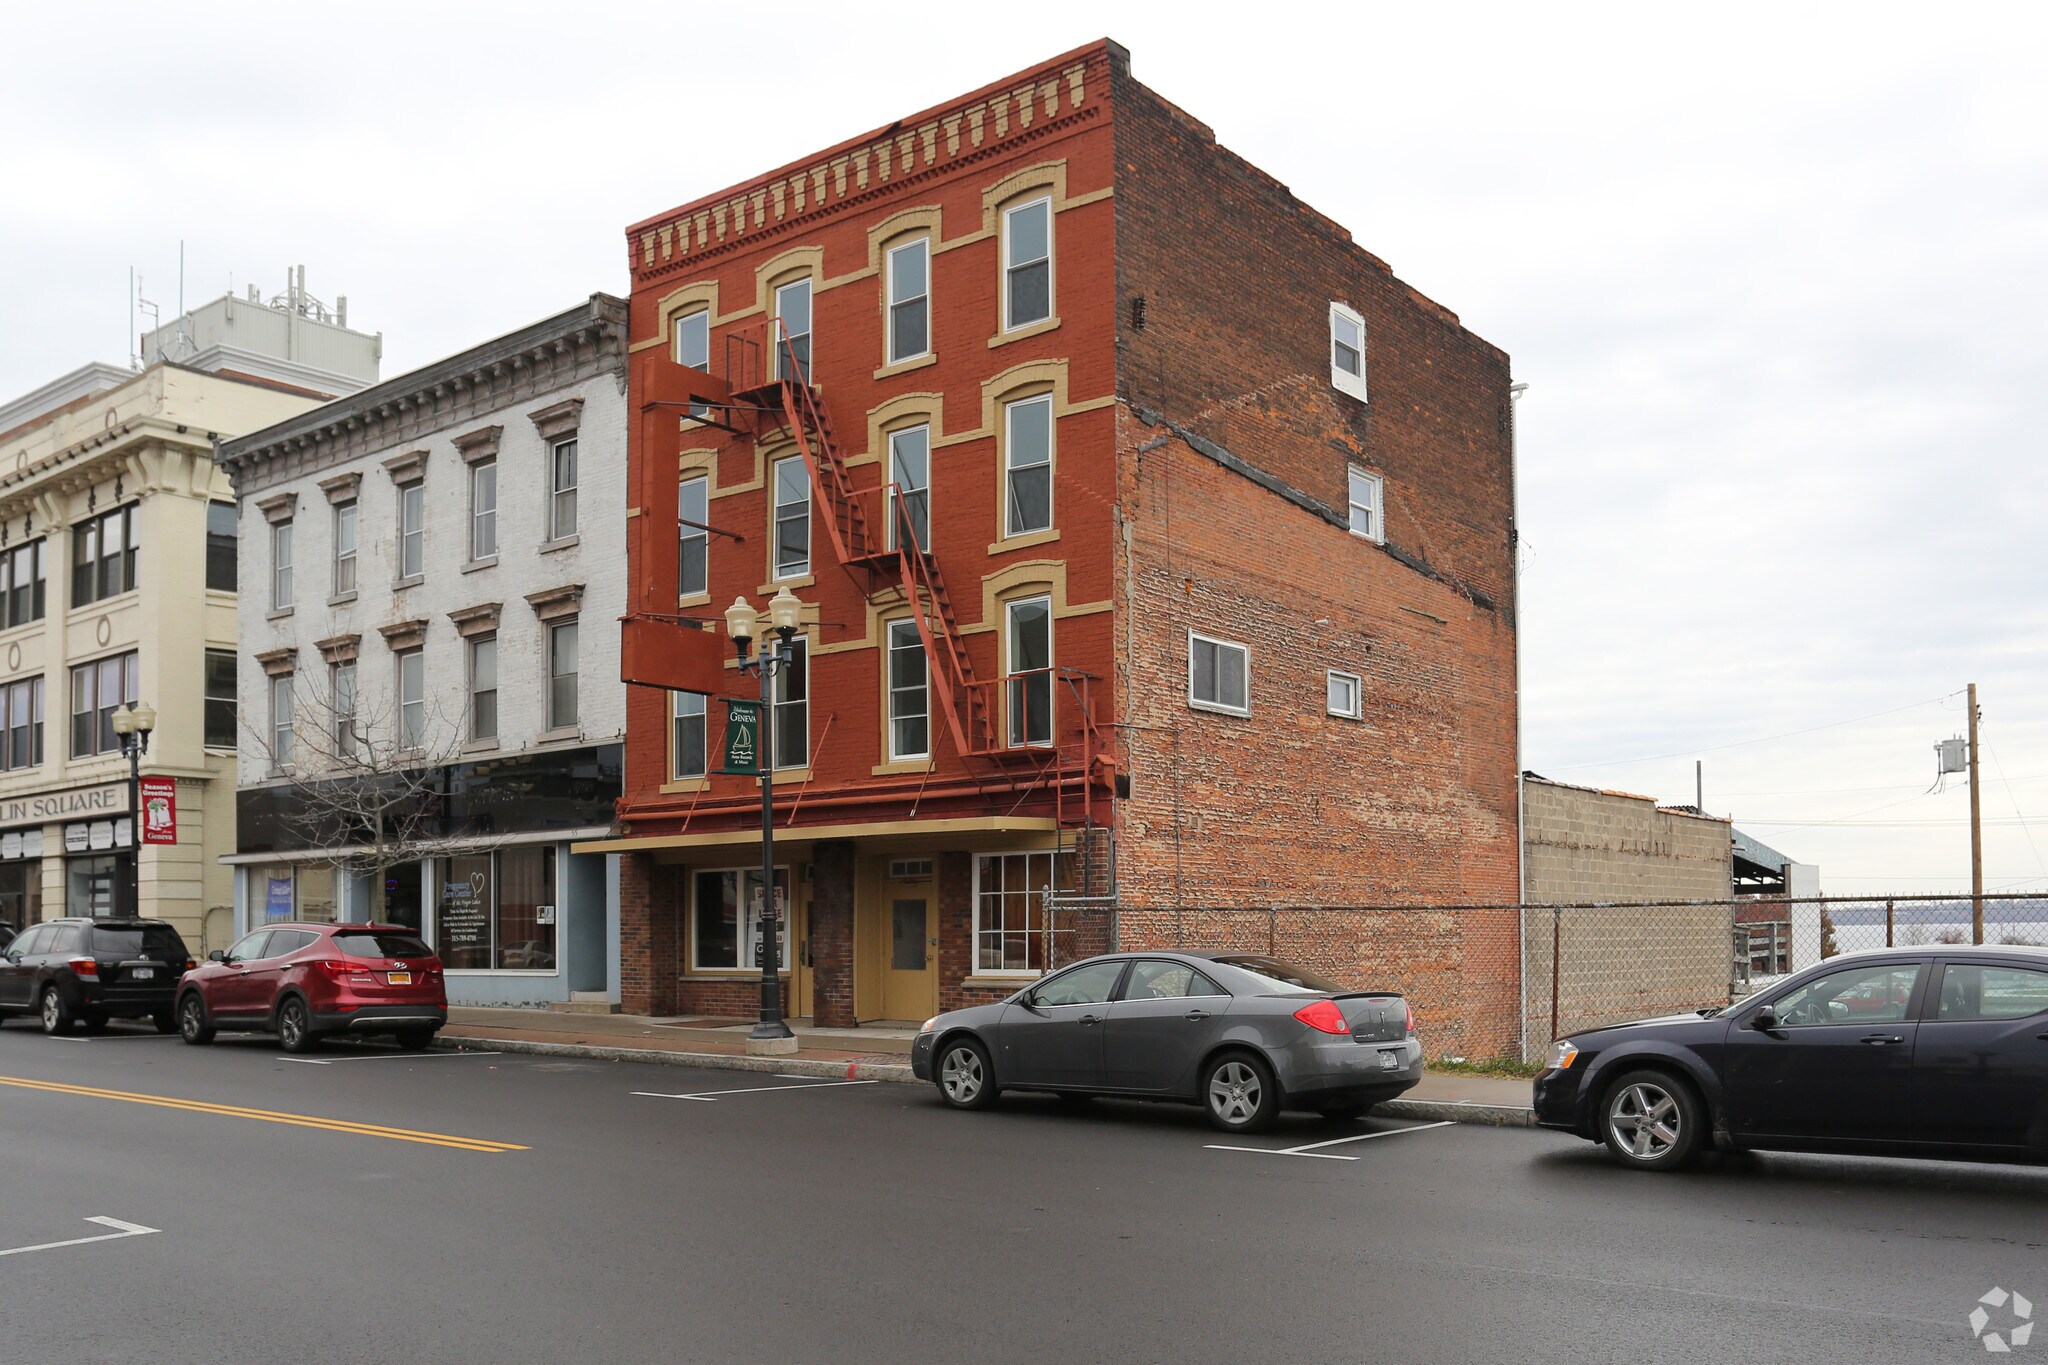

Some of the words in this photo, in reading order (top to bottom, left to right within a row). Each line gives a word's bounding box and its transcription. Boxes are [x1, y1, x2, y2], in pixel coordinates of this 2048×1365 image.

[730, 711, 756, 723] GENEVA
[142, 790, 174, 798] Greetings
[33, 788, 118, 817] SQUARE
[147, 832, 173, 840] Geneva
